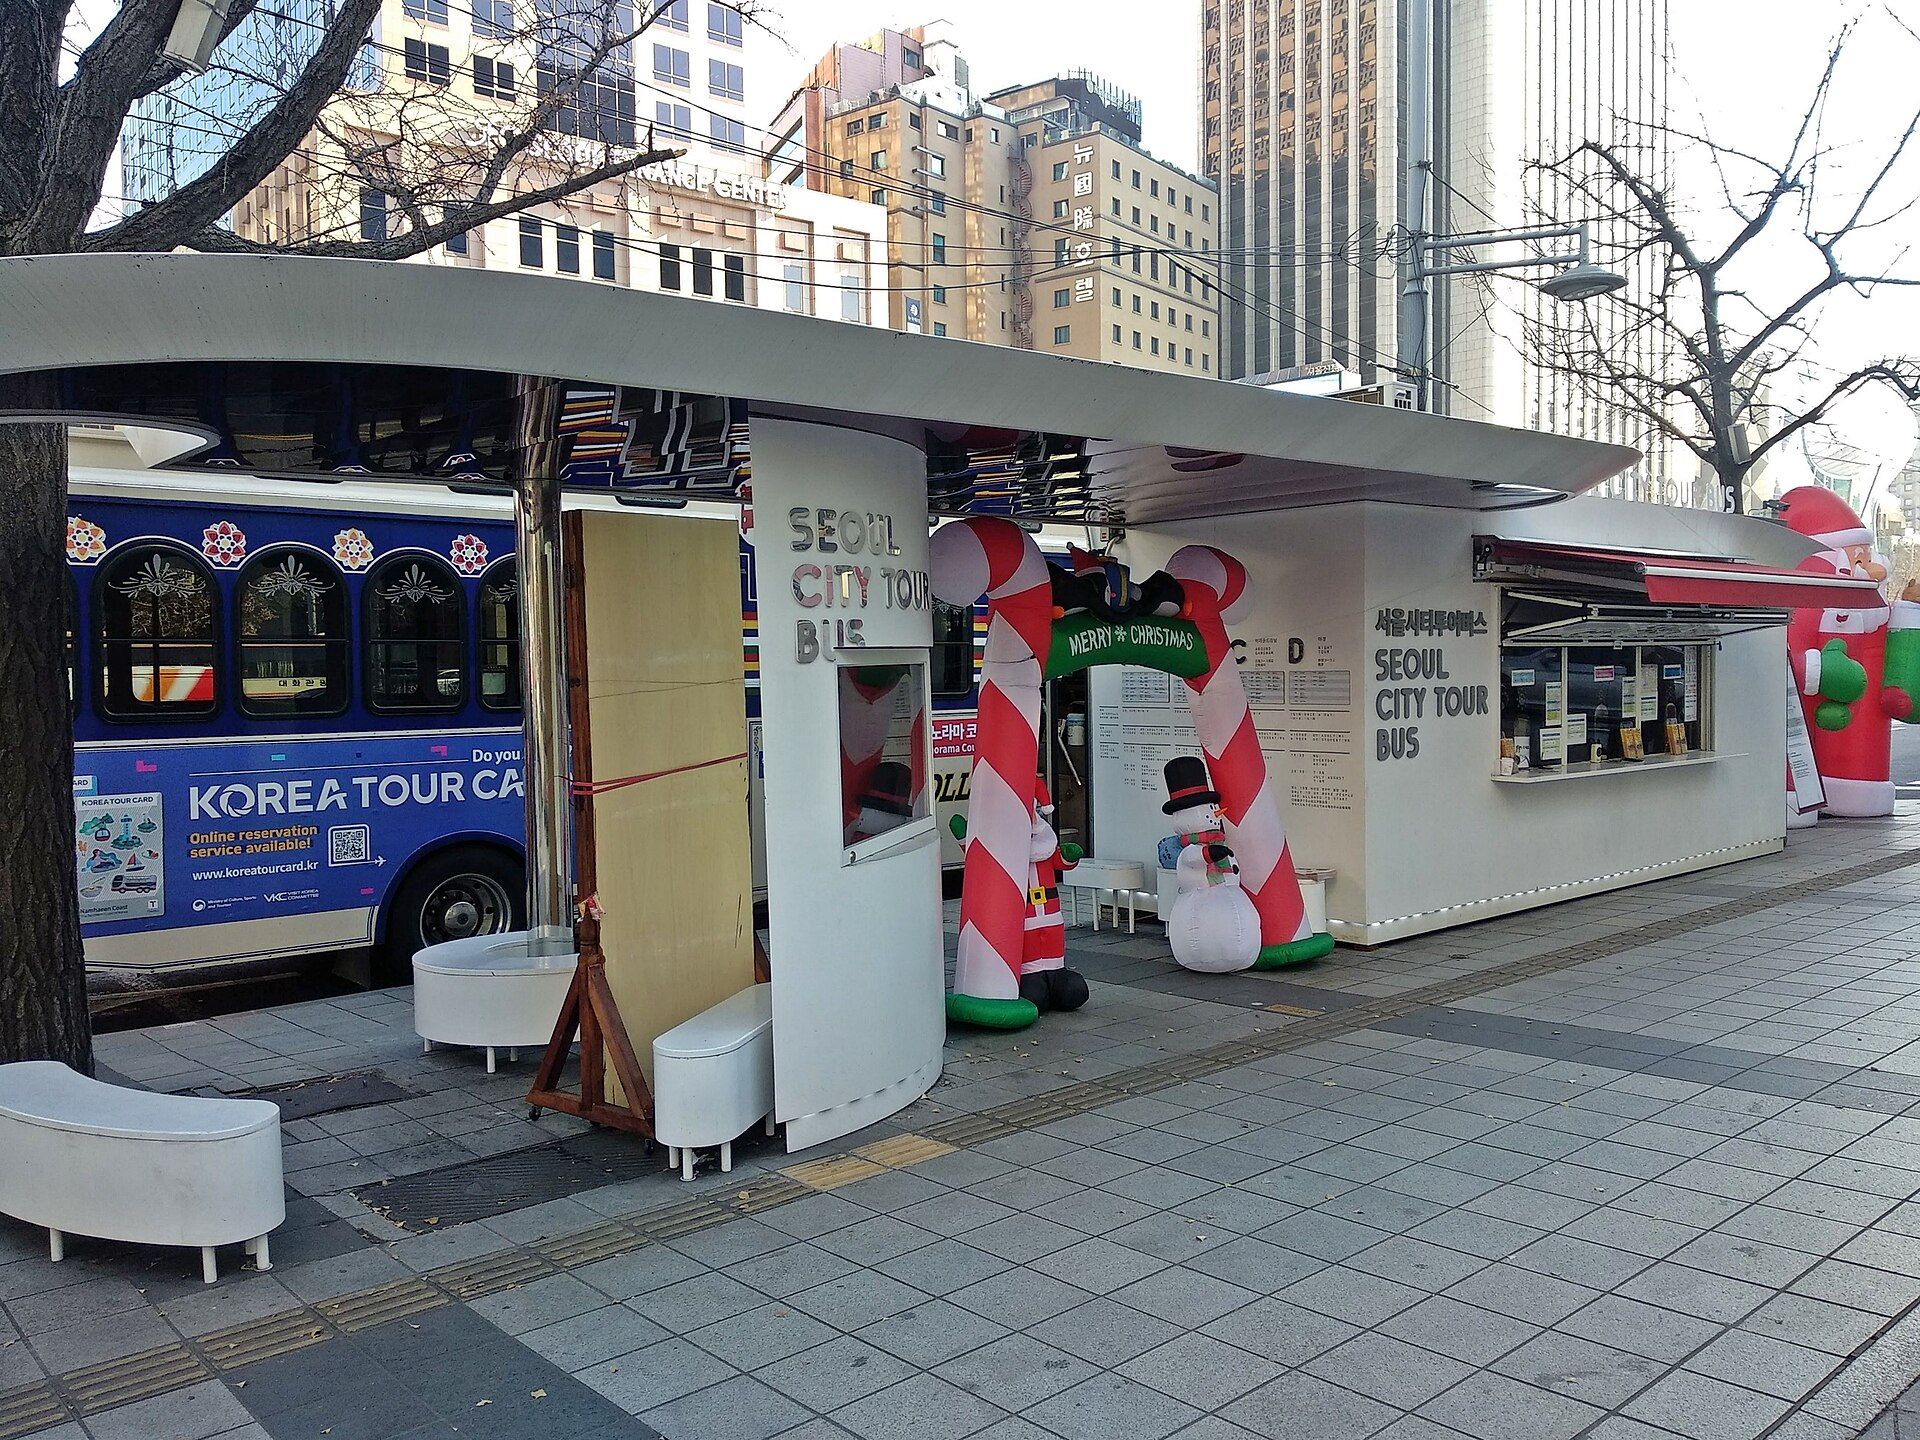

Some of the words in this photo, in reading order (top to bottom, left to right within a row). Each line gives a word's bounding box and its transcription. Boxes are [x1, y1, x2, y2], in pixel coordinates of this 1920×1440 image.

[1704, 483, 1735, 514] BUS
[788, 507, 901, 556] SEOUL
[792, 564, 871, 608] CITY
[880, 567, 929, 611] TOUR
[1375, 608, 1488, 637] 서울시티투어버스
[795, 618, 866, 664] BUS
[1069, 626, 1112, 656] MERRY
[1130, 624, 1193, 650] CHRISTMAS
[1288, 637, 1305, 664] D
[1375, 648, 1450, 681] SEOUL
[1375, 687, 1427, 721] CITY
[1433, 685, 1489, 717] TOUR
[472, 749, 493, 763] Do
[494, 750, 521, 765] you
[1376, 726, 1420, 762] BUS
[81, 799, 109, 807] KOREA
[109, 797, 131, 805] TOUR
[132, 796, 154, 804] CARD
[189, 778, 347, 820] KOREA
[352, 770, 465, 808] TOUR
[189, 831, 236, 845] Online
[239, 825, 318, 841] reservation
[190, 844, 242, 858] service
[246, 837, 311, 854] available!
[192, 860, 319, 881] www.koreatourcard.kr
[263, 892, 288, 903] VKC
